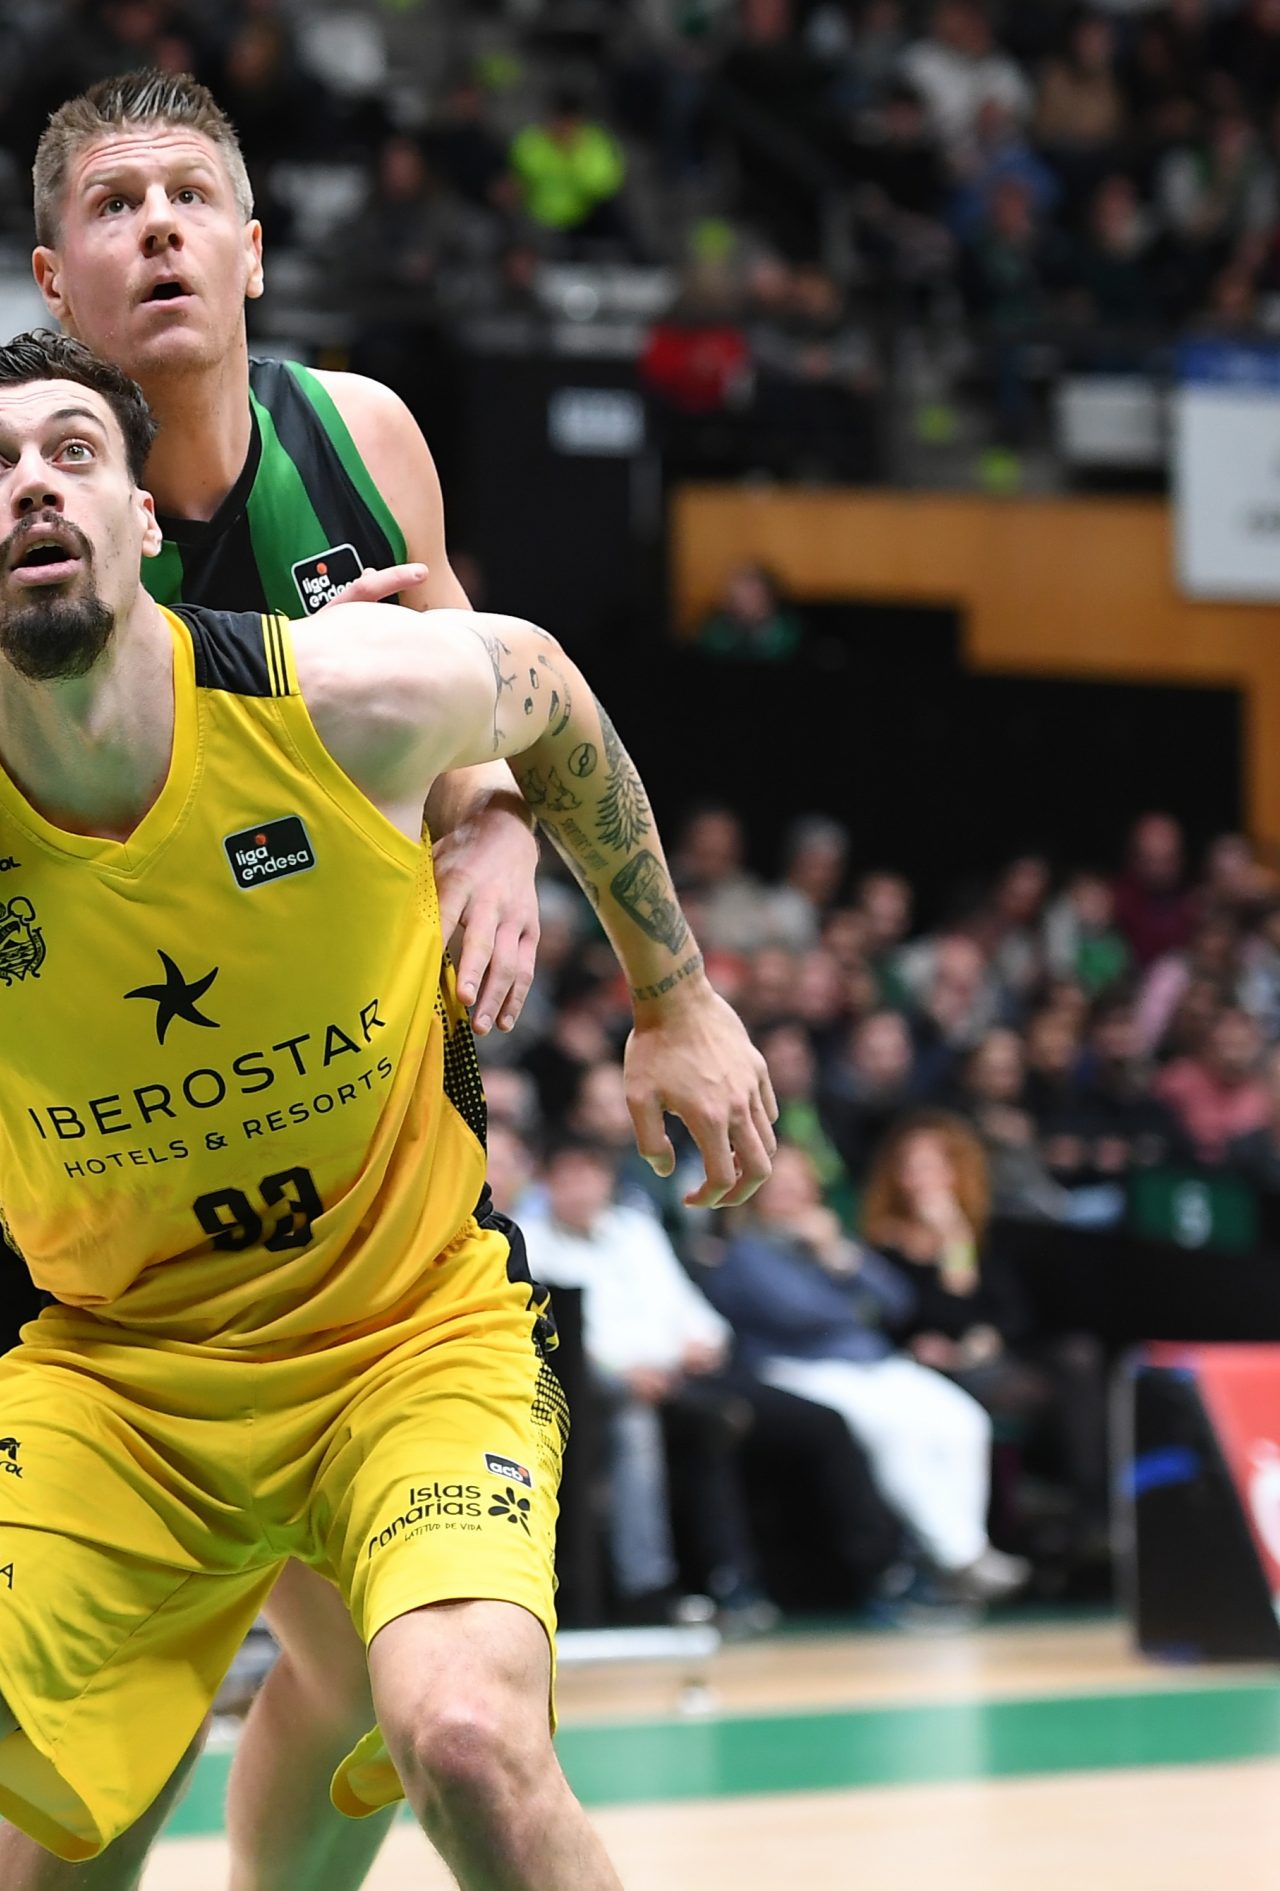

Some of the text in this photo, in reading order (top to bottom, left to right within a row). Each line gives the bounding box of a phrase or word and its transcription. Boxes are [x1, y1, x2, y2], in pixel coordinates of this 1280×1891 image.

[302, 574, 330, 595] liga
[309, 581, 355, 608] ende
[235, 846, 269, 866] liga
[242, 850, 309, 881] endesa
[28, 998, 386, 1140] IBEROSTAR
[63, 1056, 393, 1179] HOTELS & RESORTS
[489, 1462, 524, 1482] acb
[410, 1482, 482, 1506] Islas
[460, 1523, 483, 1531] VIDA
